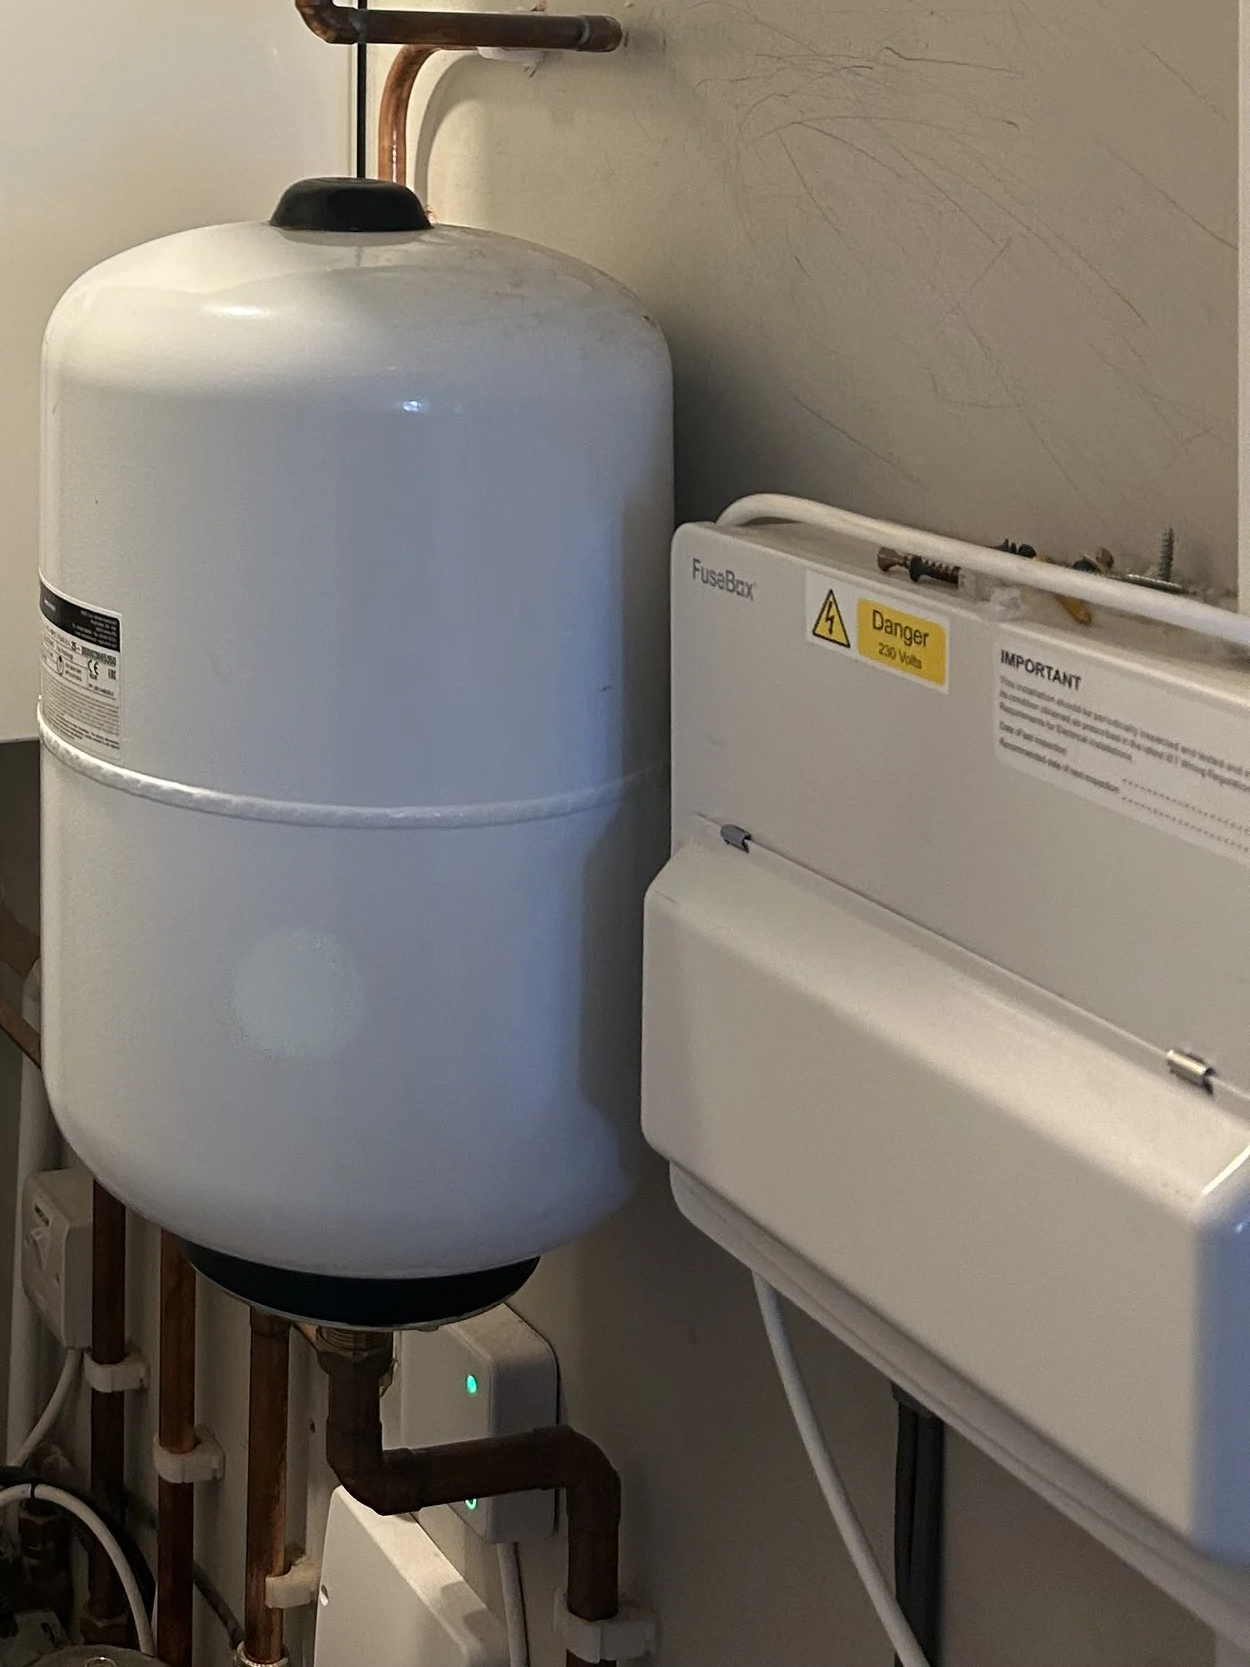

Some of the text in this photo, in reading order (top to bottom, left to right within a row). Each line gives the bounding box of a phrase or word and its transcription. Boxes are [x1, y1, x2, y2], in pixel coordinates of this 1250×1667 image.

[692, 557, 754, 602] FuseBox
[872, 609, 930, 647] Danger
[878, 642, 922, 669] 230 Volts
[1000, 649, 1082, 691] IMPORTANT
